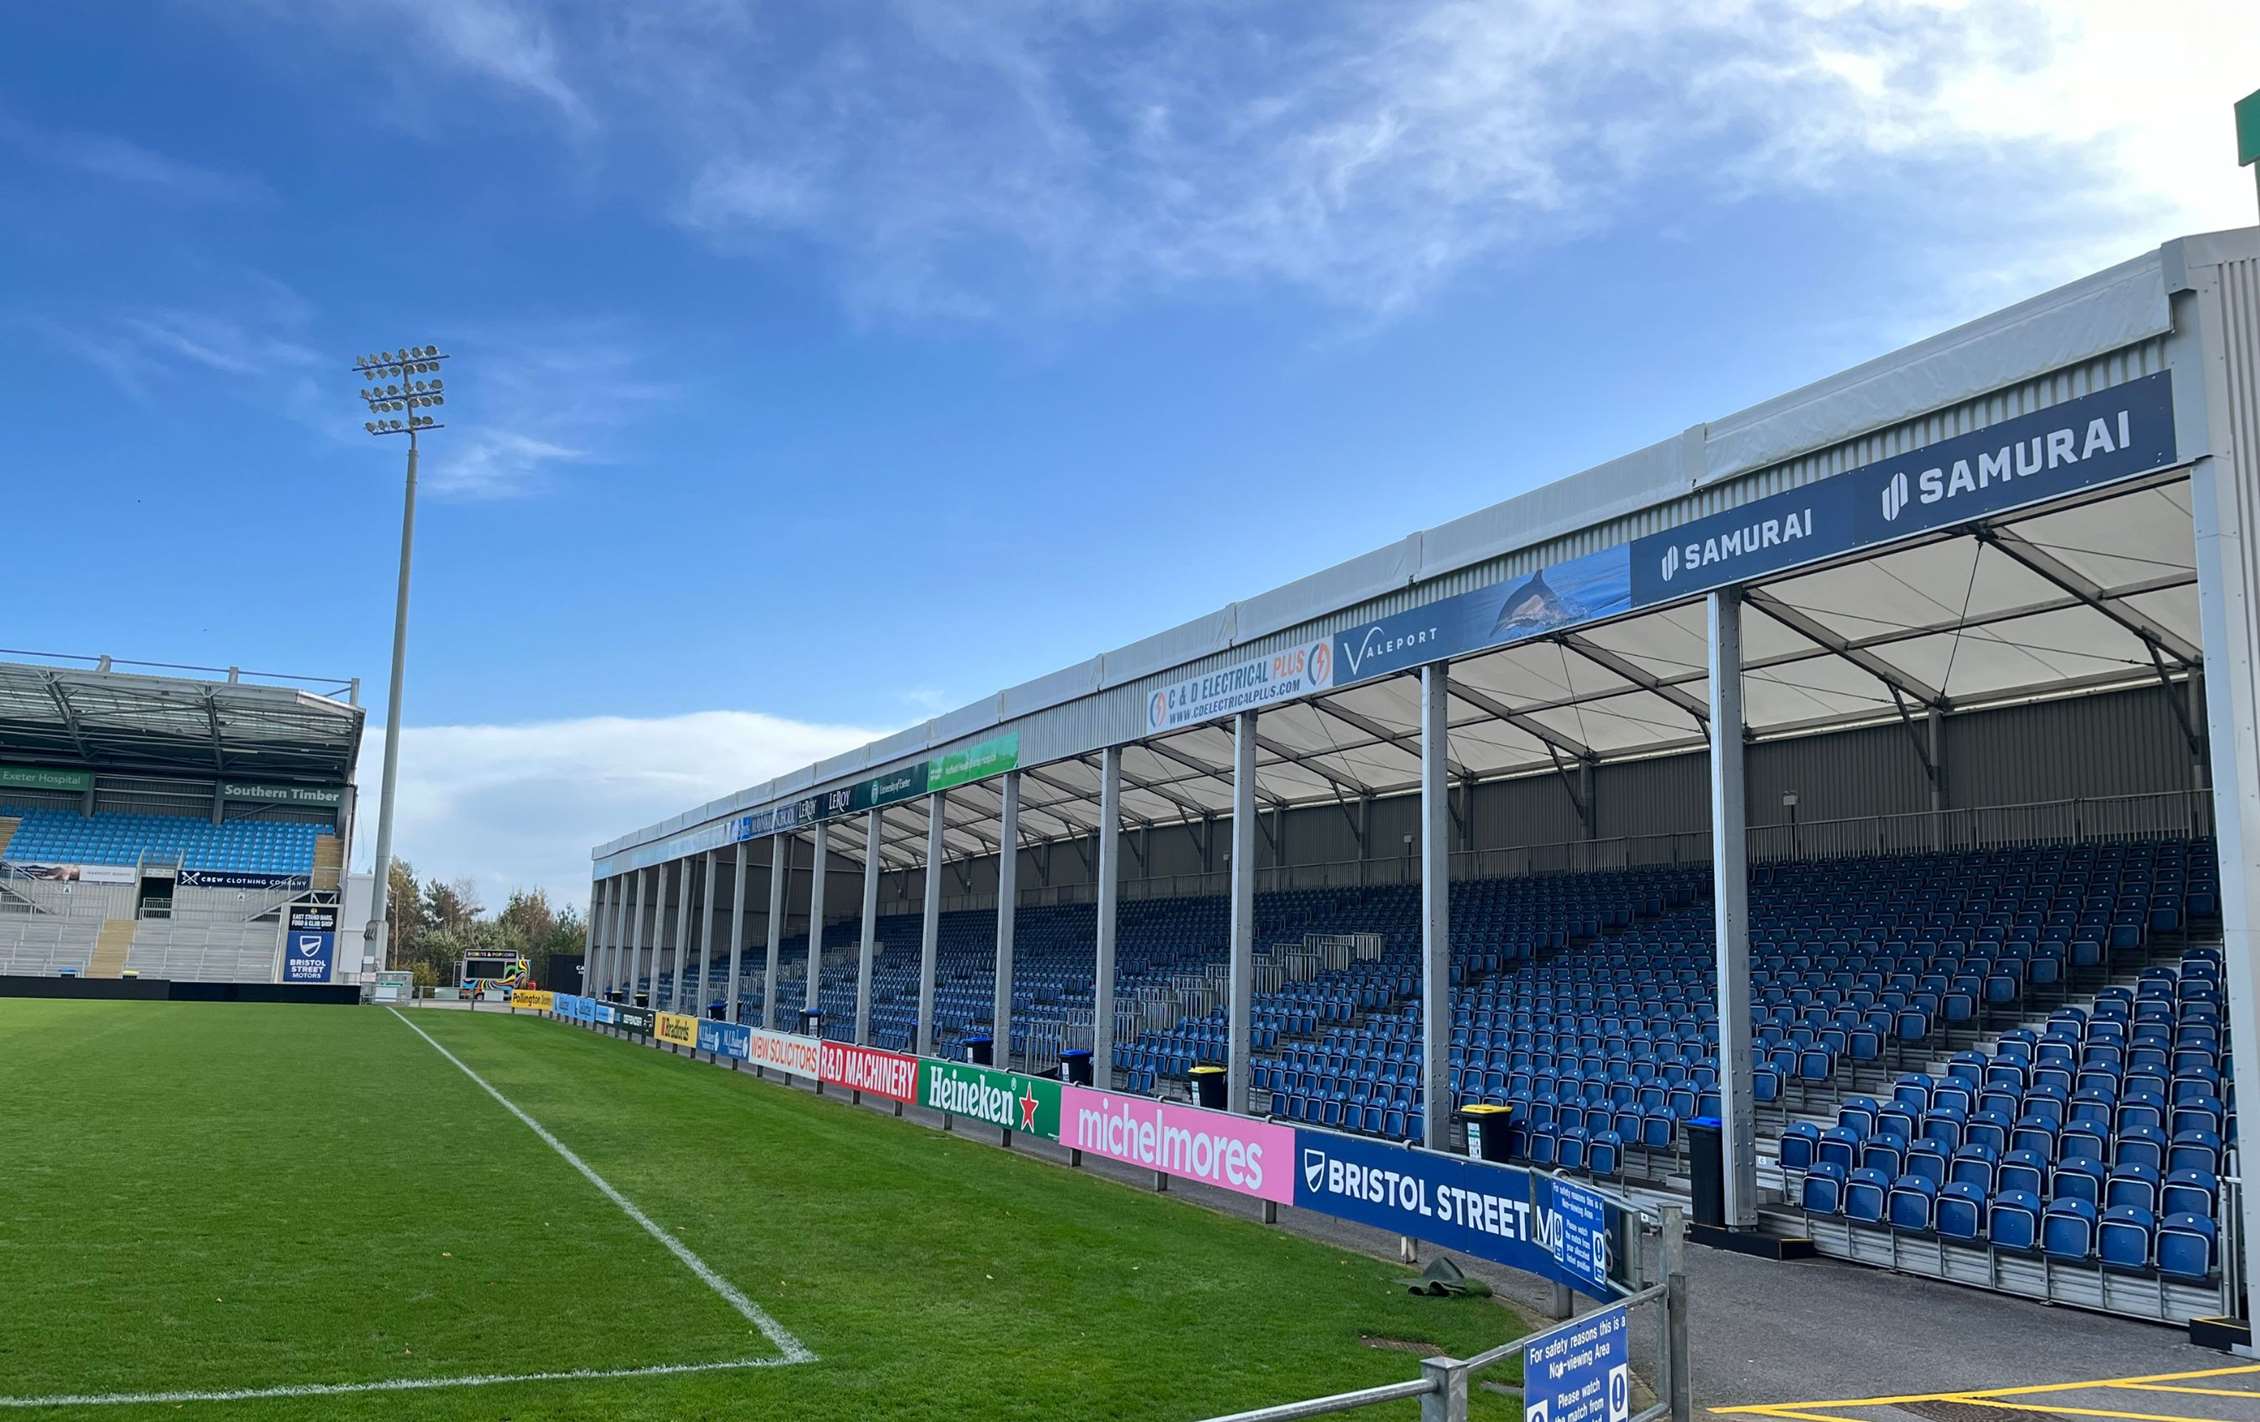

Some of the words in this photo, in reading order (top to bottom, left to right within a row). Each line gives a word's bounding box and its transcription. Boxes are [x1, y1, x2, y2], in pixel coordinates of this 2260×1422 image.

[1919, 410, 2131, 505] SAMURAI
[1685, 508, 1812, 570] SAMURAI
[1343, 626, 1437, 676] VALEPORT
[1168, 689, 1176, 709] C
[1180, 685, 1186, 706] &
[1191, 682, 1198, 703] D
[1202, 661, 1268, 700] ELECTRICAL
[1273, 650, 1305, 680] PLUS
[1169, 679, 1300, 725] WWW.CDELECTRICALPLUS.COM
[3, 771, 35, 780] Exeter
[39, 773, 80, 784] Hospital
[224, 785, 287, 798] Southern
[291, 788, 338, 801] Timber
[665, 1017, 689, 1041] Bradfords
[769, 1038, 816, 1073] SOLICITORS
[820, 1046, 843, 1082] R&D
[844, 1050, 917, 1099] MACHINERY
[929, 1066, 1014, 1127] Heineken
[1078, 1098, 1262, 1190] michelmores
[1328, 1159, 1432, 1216] BRISTOL
[1437, 1184, 1530, 1241] STREET
[1530, 1348, 1542, 1365] For
[1545, 1338, 1568, 1359] safety
[1570, 1326, 1598, 1348] reasons
[1600, 1319, 1612, 1336] this
[1614, 1316, 1620, 1330] is
[1622, 1316, 1626, 1328] a
[1549, 1350, 1592, 1379] Non-viewing
[1595, 1342, 1610, 1360] Area
[1558, 1390, 1580, 1410] Please
[1582, 1377, 1600, 1398] watch
[1568, 1403, 1588, 1422] match
[1590, 1398, 1604, 1414] from
